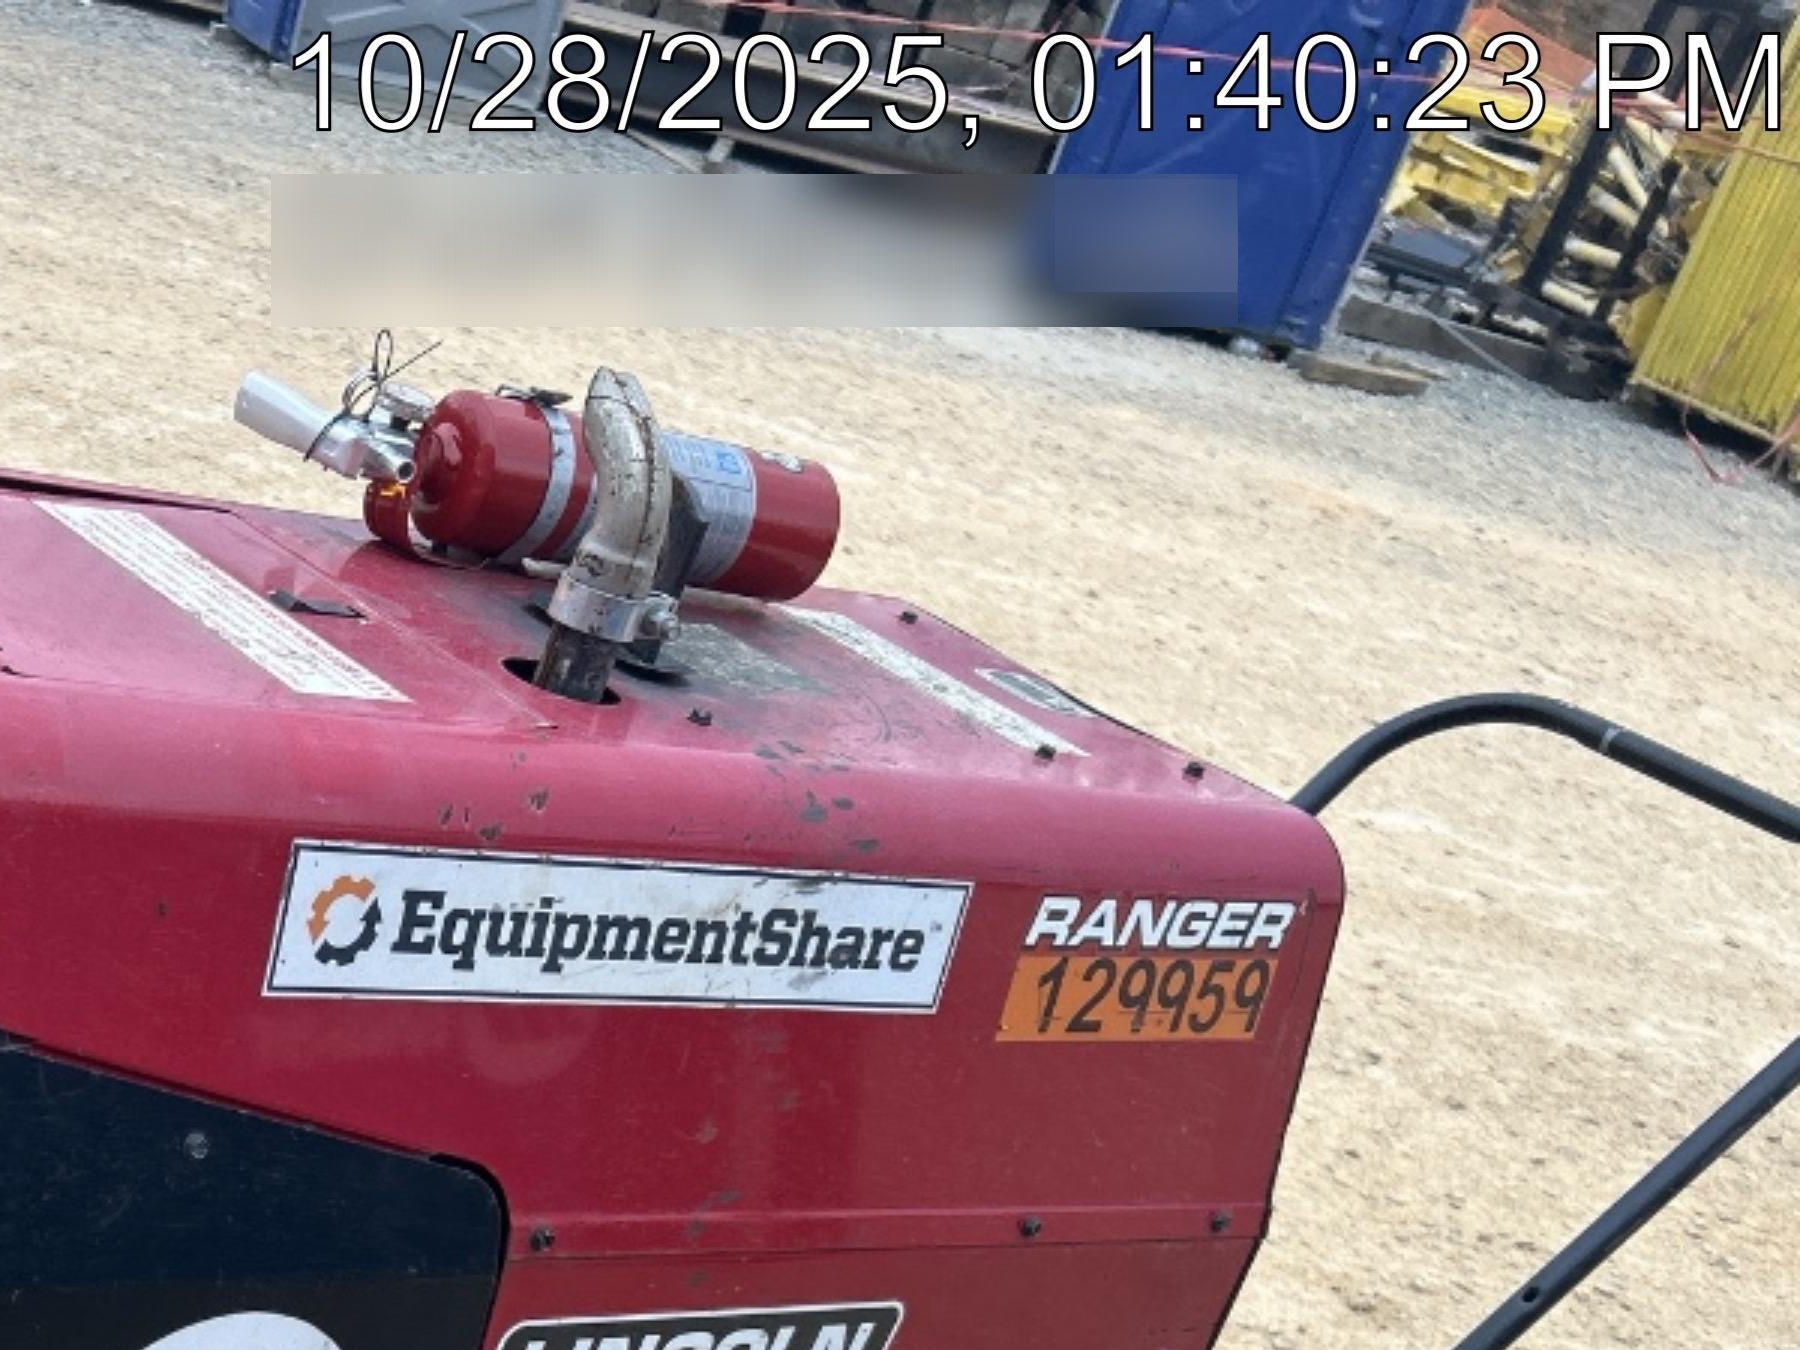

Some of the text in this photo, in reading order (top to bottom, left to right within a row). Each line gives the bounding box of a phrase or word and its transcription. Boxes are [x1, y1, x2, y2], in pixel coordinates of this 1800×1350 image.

[390, 889, 926, 972] EquipmentShare
[1025, 896, 1296, 949] RANGER
[1036, 957, 1271, 1033] 129959
